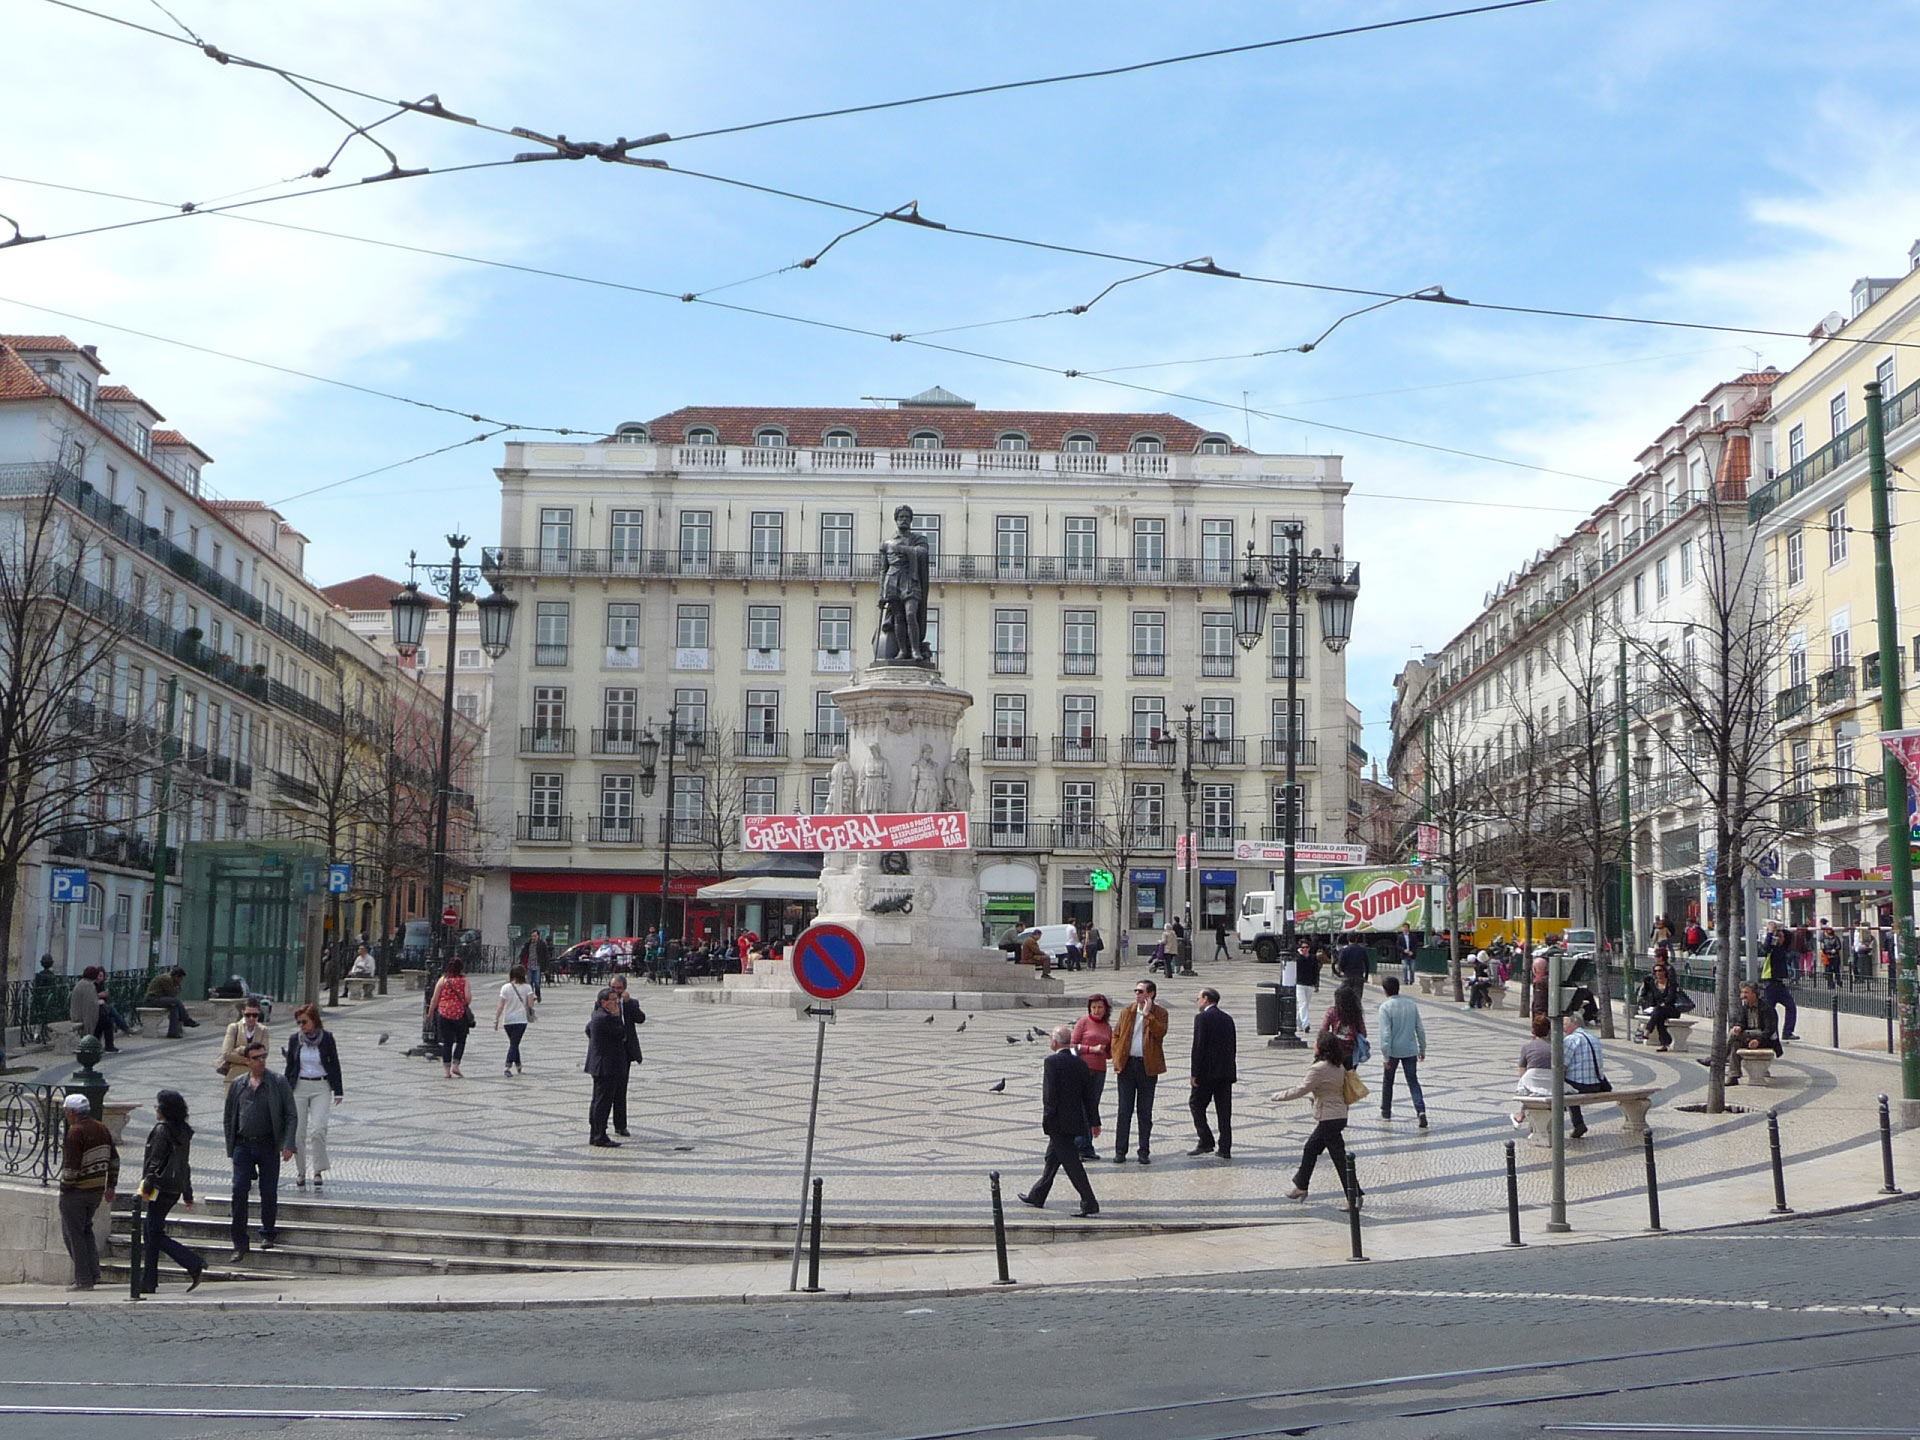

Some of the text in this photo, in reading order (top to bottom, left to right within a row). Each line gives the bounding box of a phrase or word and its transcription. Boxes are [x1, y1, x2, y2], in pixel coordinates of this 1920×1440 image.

[745, 815, 889, 851] GREVE GERAL
[937, 815, 960, 836] 22
[942, 833, 966, 847] MAR.
[53, 876, 71, 898] P
[330, 870, 346, 891] P
[1322, 885, 1333, 899] P
